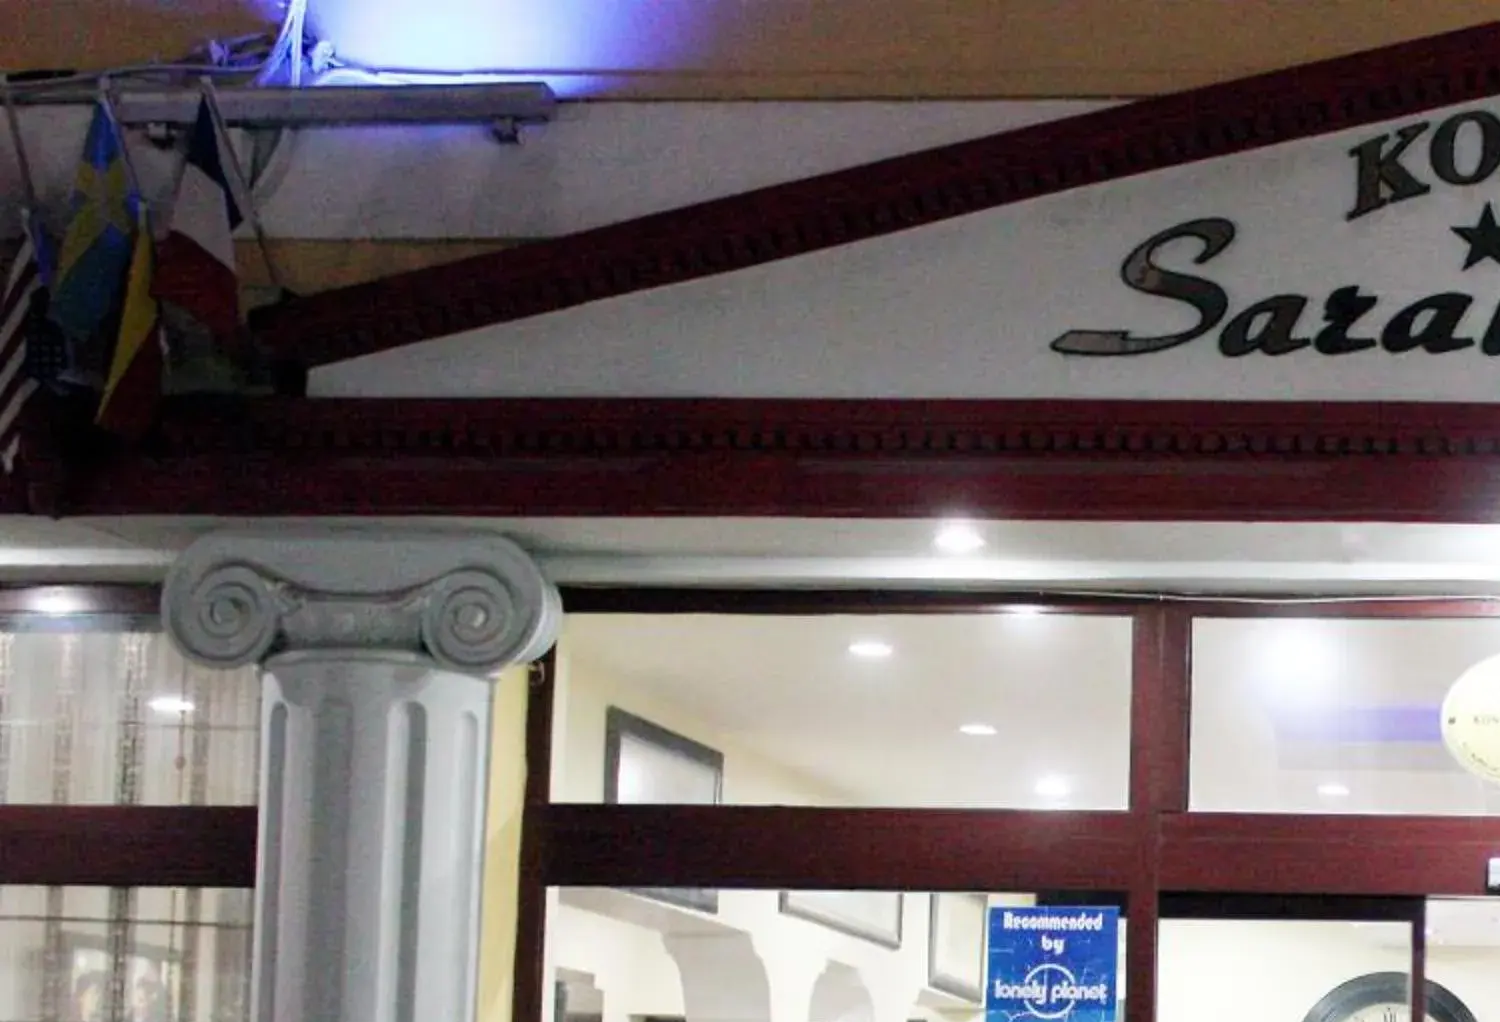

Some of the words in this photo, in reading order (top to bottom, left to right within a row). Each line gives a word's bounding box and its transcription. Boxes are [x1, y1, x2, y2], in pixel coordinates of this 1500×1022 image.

[1003, 911, 1103, 931] Recommended
[1041, 935, 1065, 955] by
[995, 979, 1047, 1005] lonely
[1050, 980, 1107, 1005] planet
